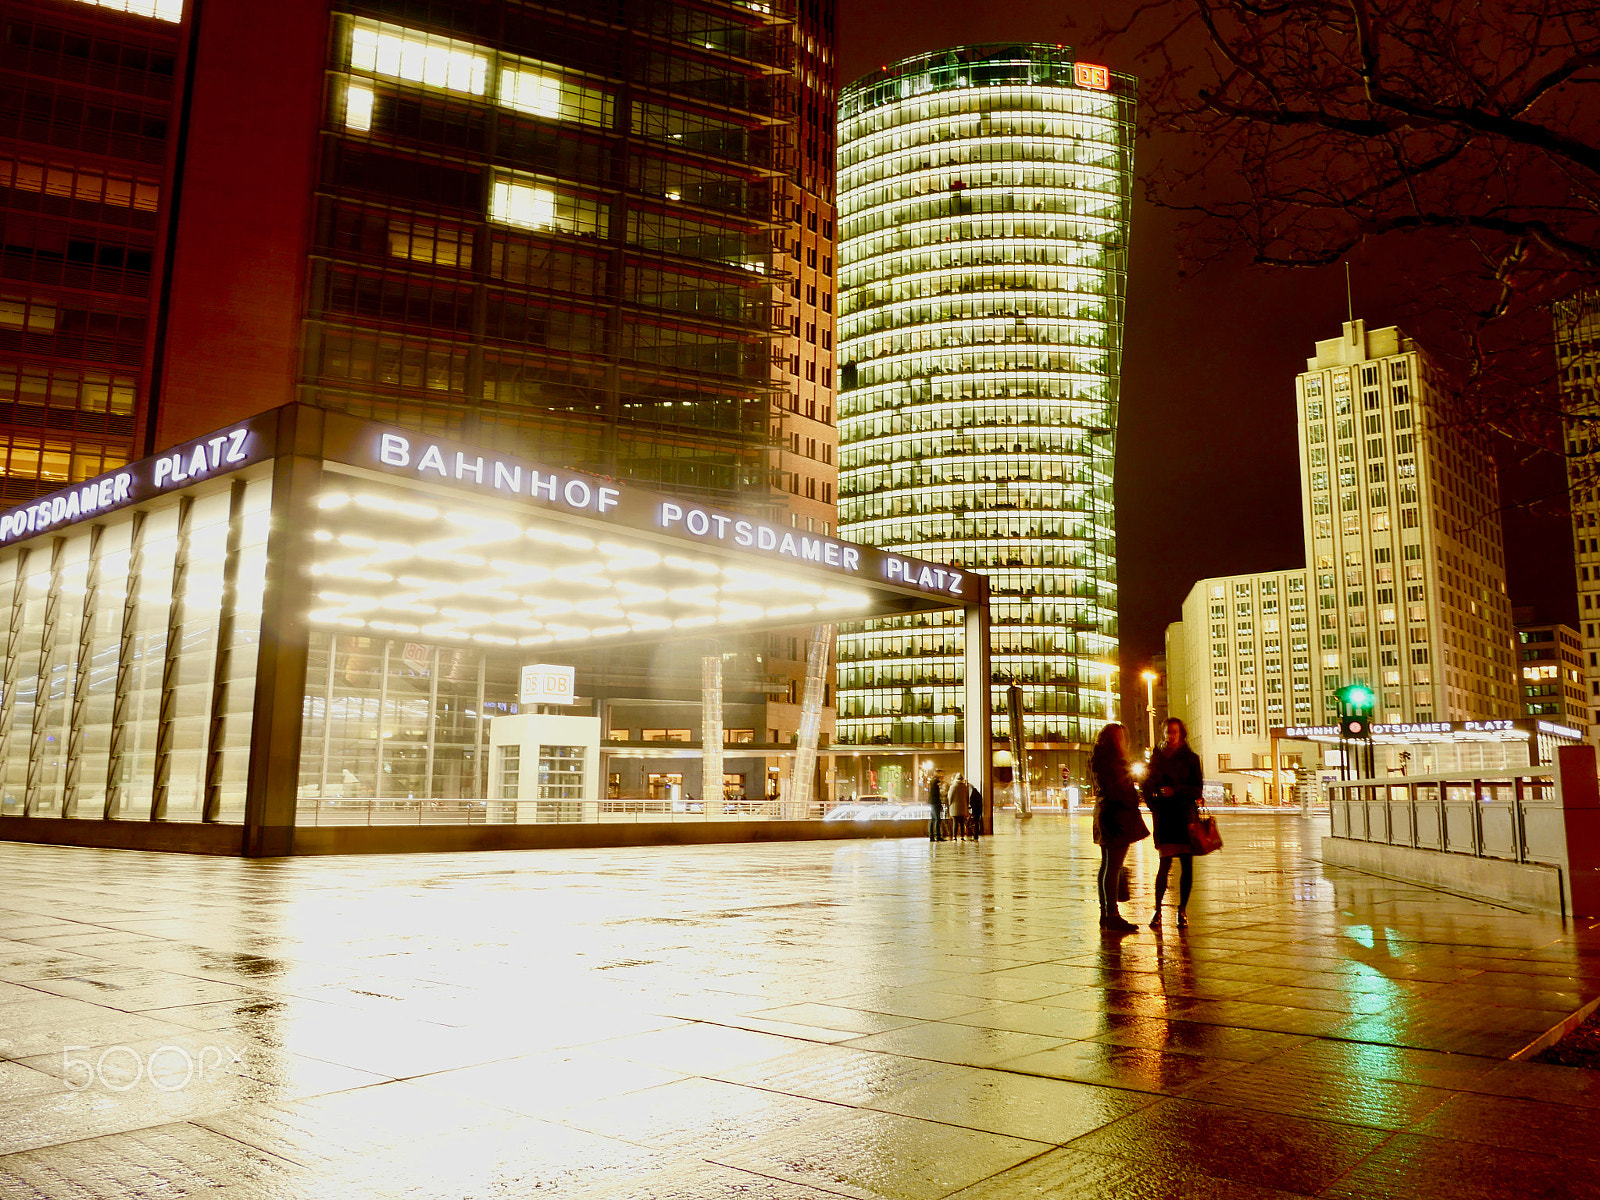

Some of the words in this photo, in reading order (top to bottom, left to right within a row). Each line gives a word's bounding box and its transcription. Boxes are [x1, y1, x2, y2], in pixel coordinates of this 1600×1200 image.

[0, 472, 132, 541] POTSDAMER
[154, 429, 249, 488] PLATZ
[380, 433, 620, 512] BAHNHOF
[661, 502, 860, 570] POTSDAMER
[886, 557, 963, 594] PLATZ
[546, 676, 567, 692] DB
[1286, 726, 1340, 737] BAHNHO
[1373, 722, 1452, 734] OTSDAMER
[1465, 720, 1514, 731] PLATZ
